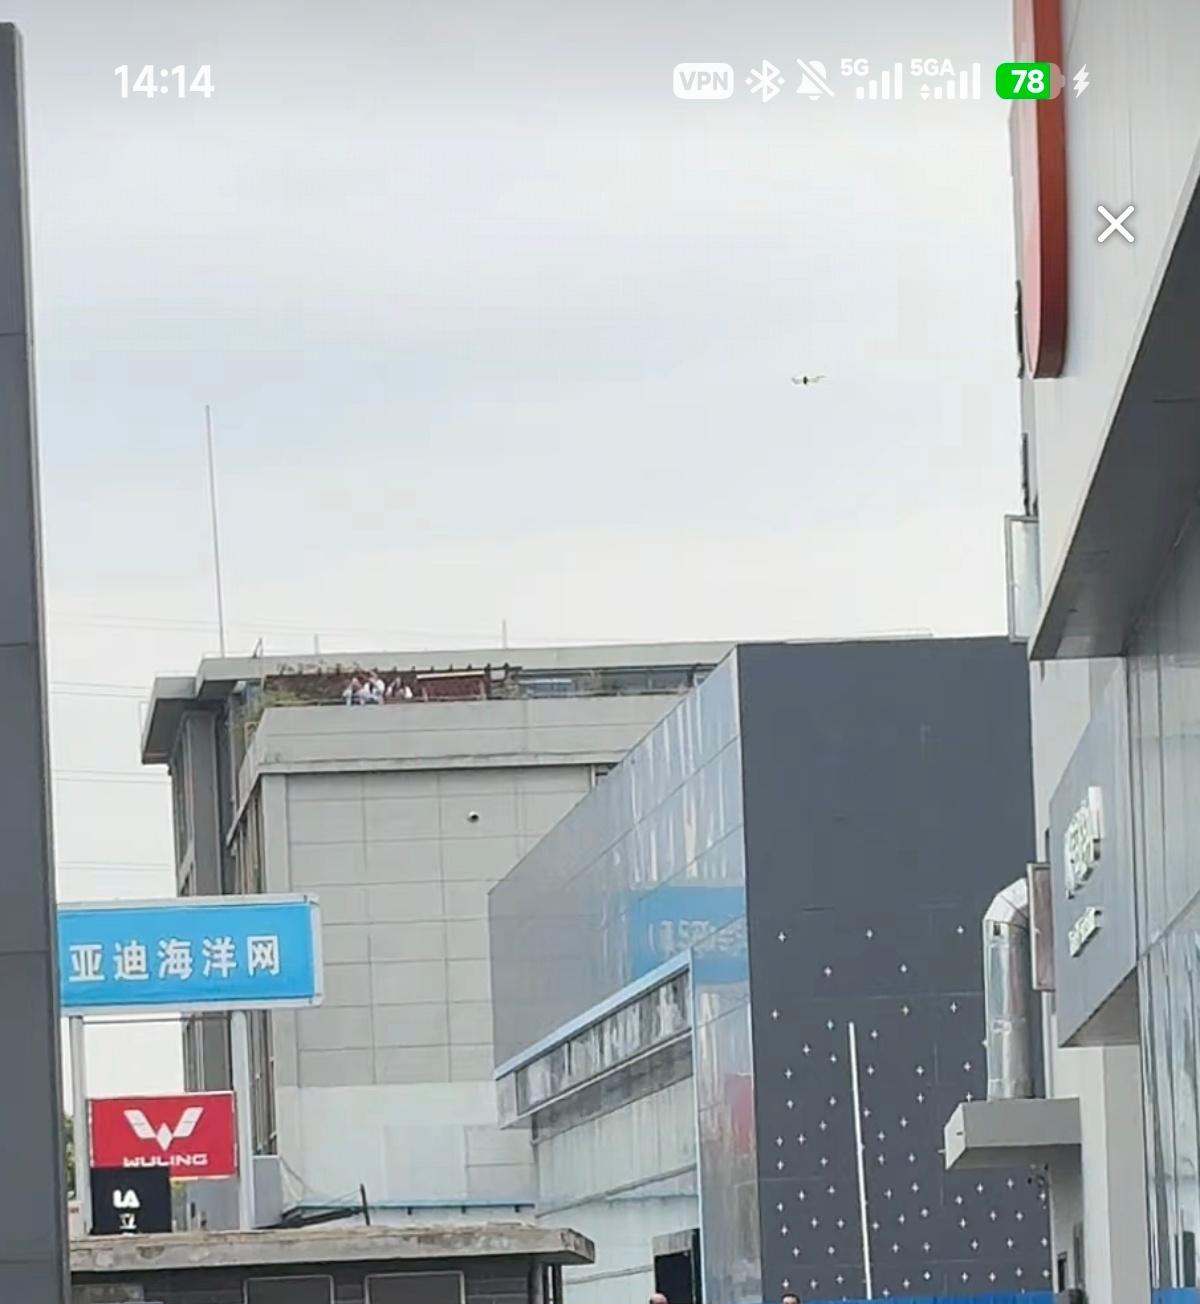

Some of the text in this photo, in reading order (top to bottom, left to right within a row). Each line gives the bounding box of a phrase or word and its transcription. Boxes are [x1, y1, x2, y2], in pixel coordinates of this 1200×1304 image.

[68, 935, 281, 982] 亚迪海洋网
[123, 1153, 208, 1168] WULING
